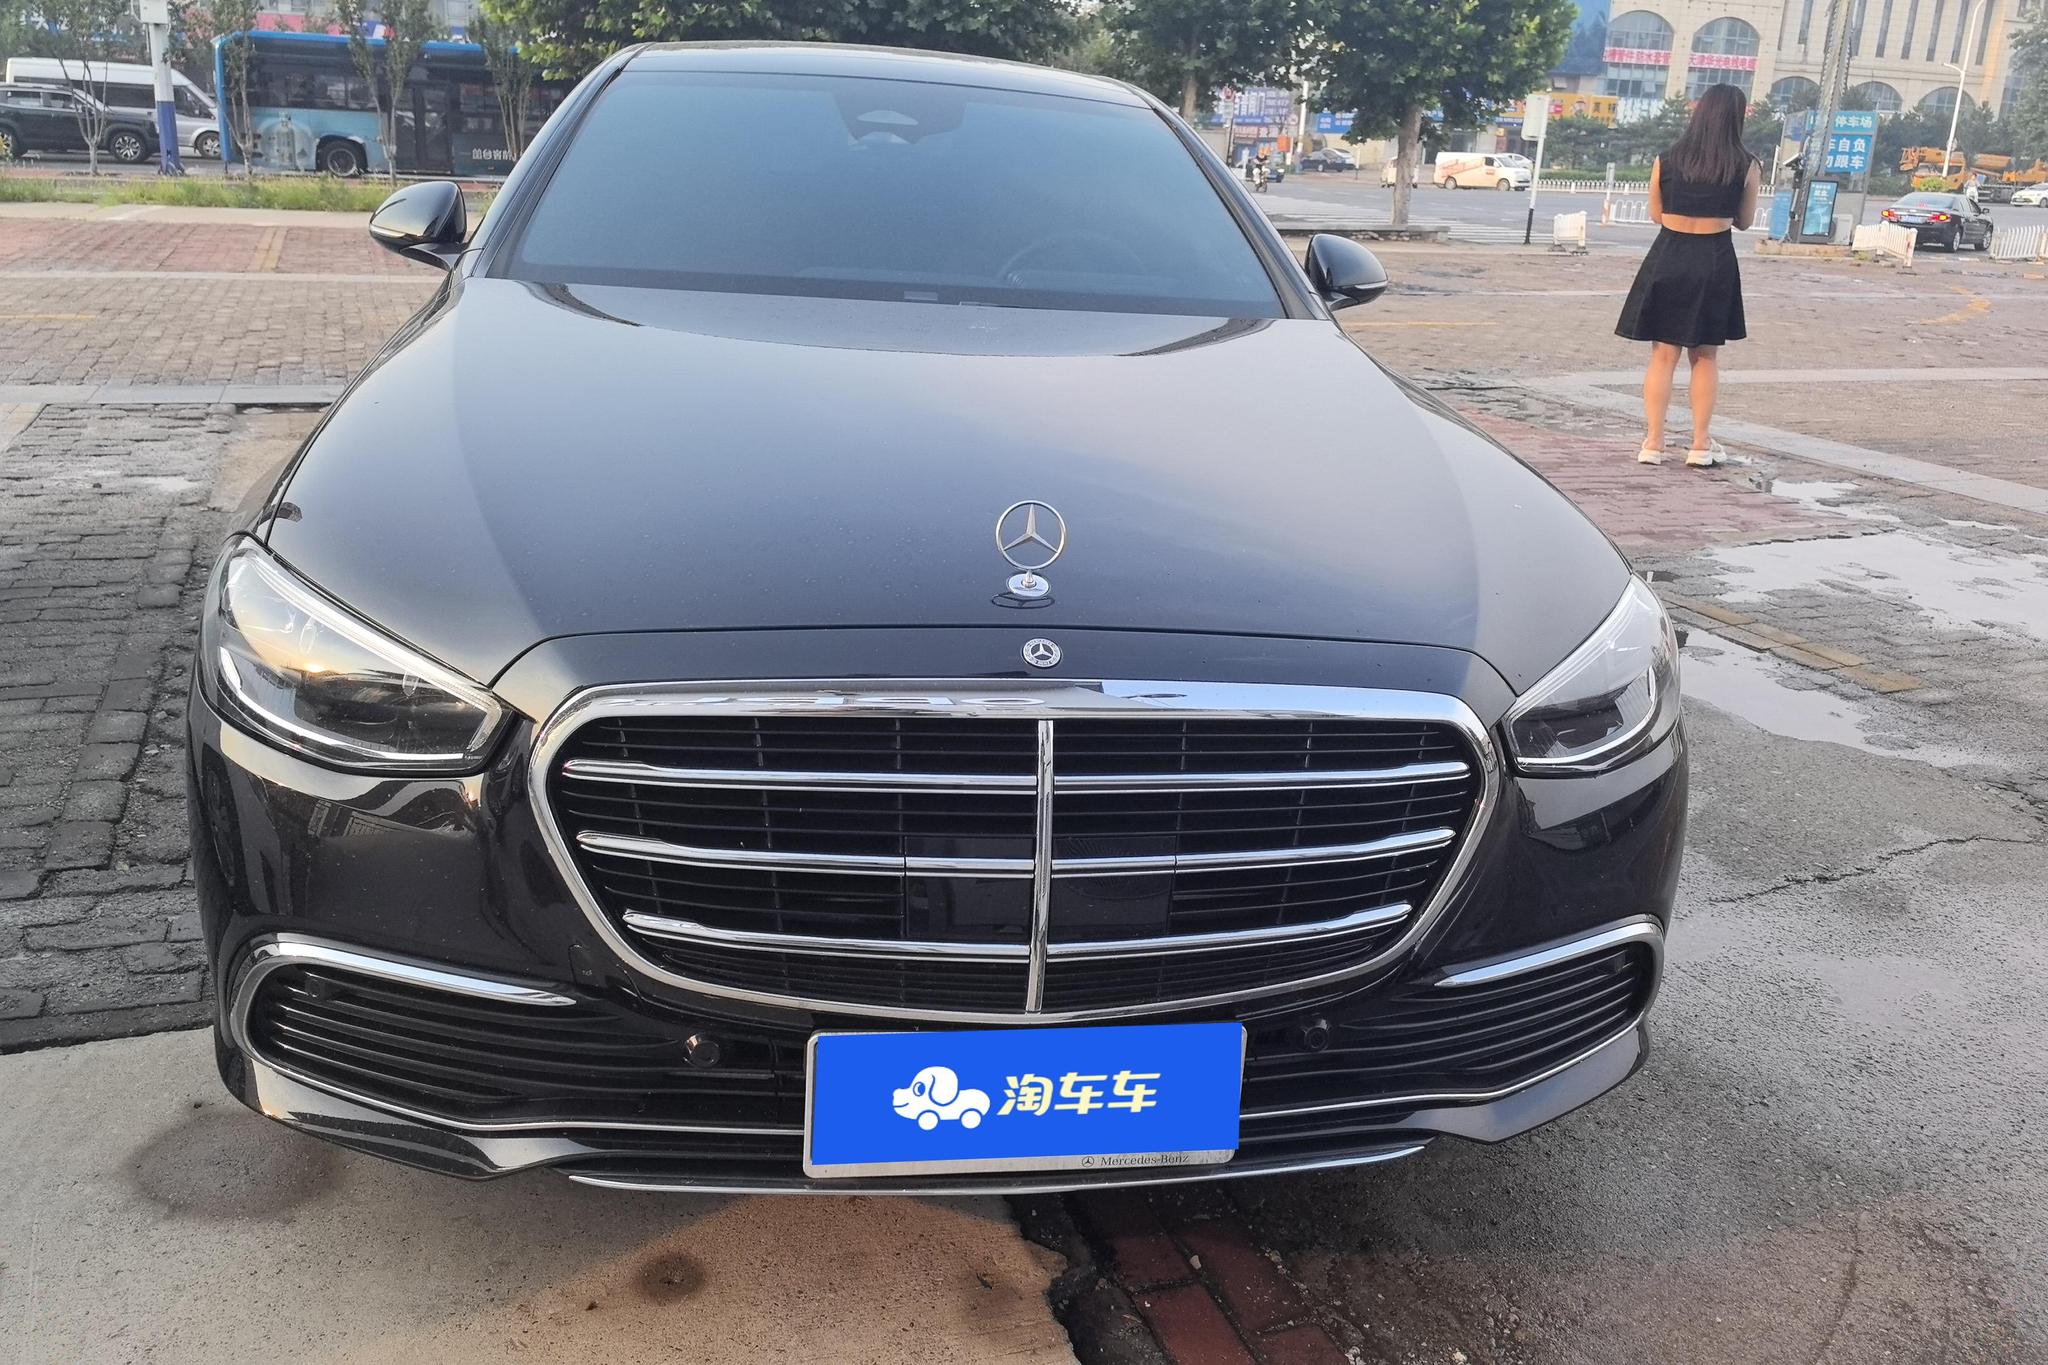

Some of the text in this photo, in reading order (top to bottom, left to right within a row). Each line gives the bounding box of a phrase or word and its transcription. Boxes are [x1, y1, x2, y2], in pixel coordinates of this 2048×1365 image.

[1835, 115, 1872, 128] 停车场
[1100, 1154, 1189, 1166] Mercedes-Benz
